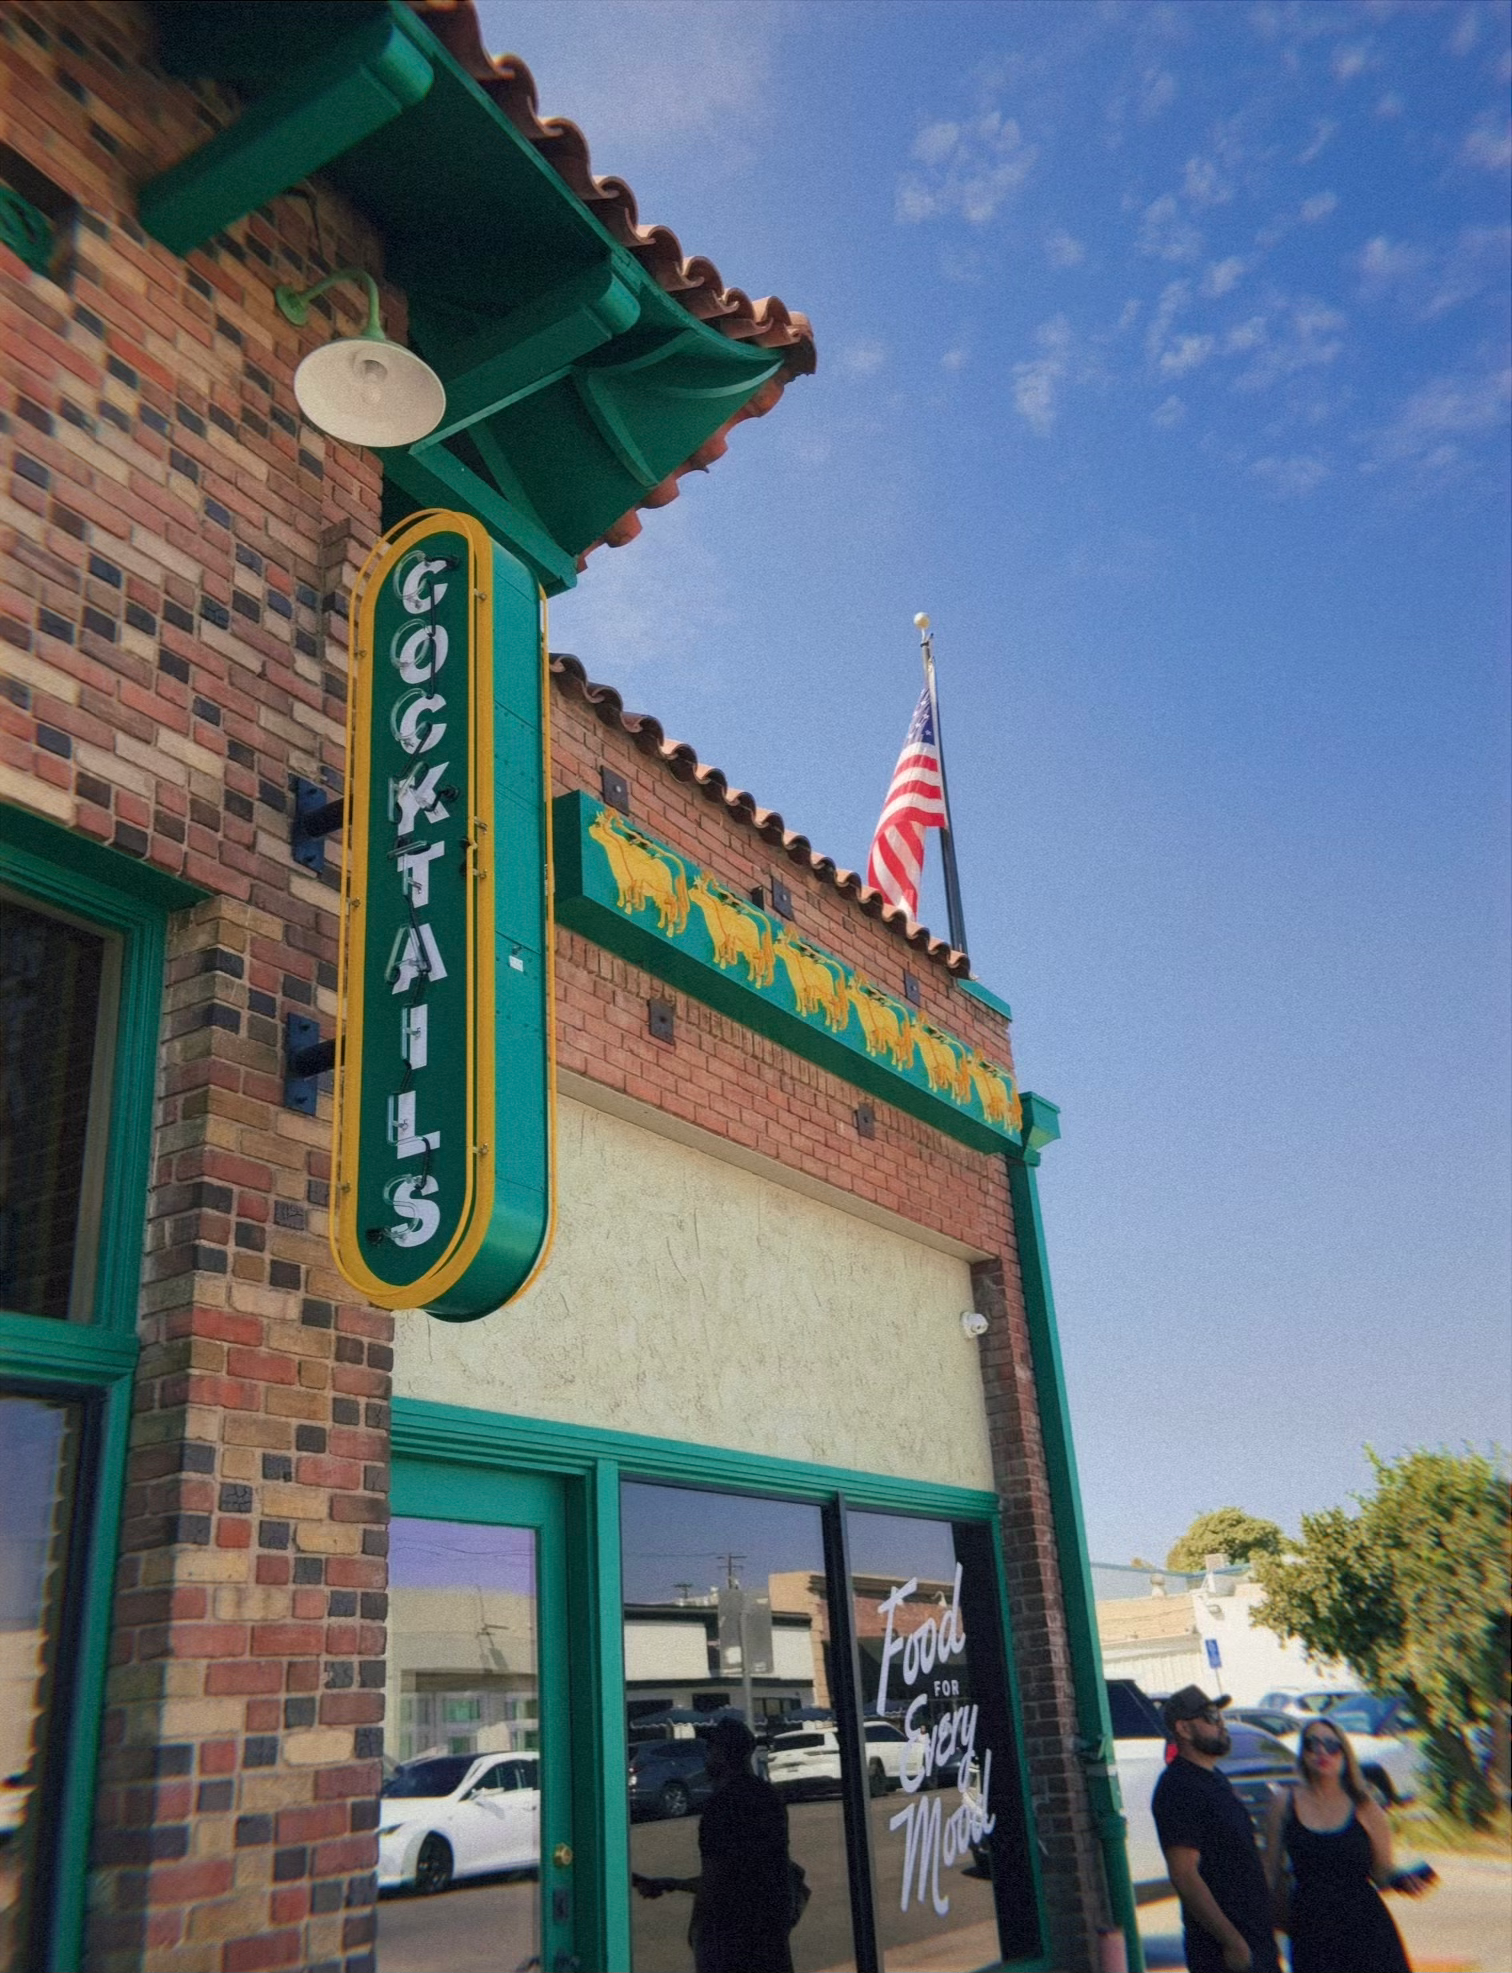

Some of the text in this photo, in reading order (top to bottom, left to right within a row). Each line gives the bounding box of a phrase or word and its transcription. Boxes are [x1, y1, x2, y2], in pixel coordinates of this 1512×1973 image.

[387, 551, 450, 1249] COCKTAILS
[877, 1562, 966, 1716] Food
[933, 1679, 960, 1698] FOR
[899, 1693, 979, 1793] Every
[889, 1749, 996, 1916] Mood
